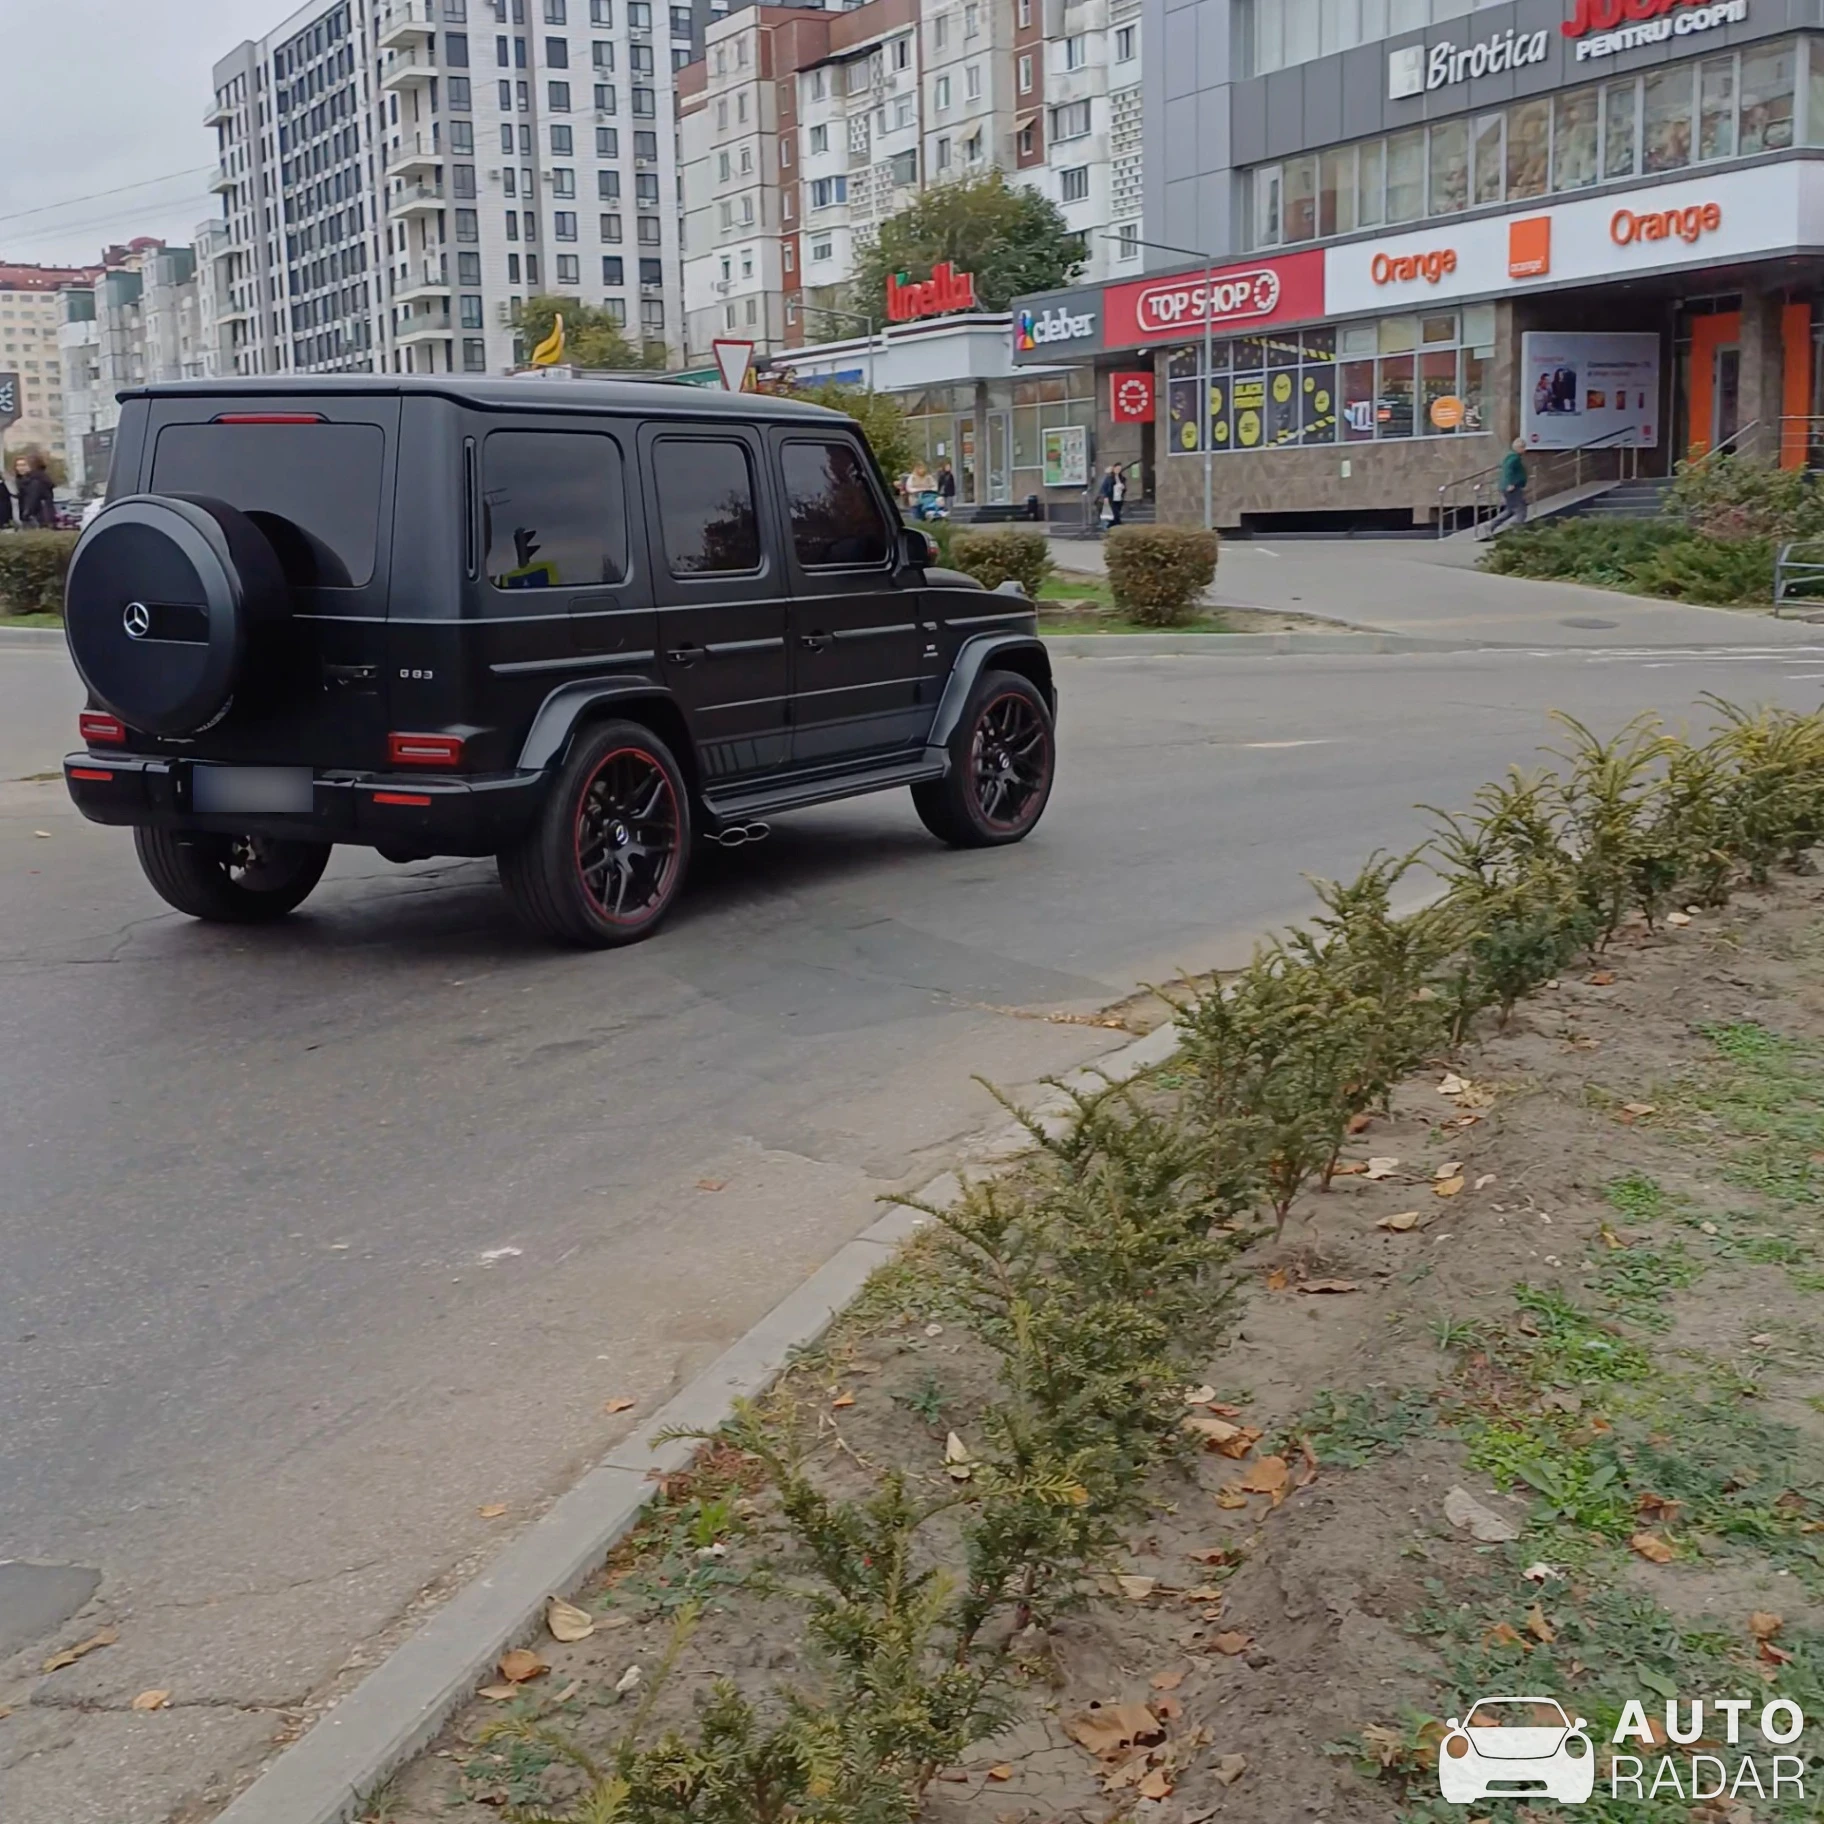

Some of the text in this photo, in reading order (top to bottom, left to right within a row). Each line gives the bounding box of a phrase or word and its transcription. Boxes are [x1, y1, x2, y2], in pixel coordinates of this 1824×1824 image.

[1576, 18, 1673, 62] PENTRU
[1674, 0, 1747, 35] COPII
[1426, 28, 1548, 90] Birotica
[1609, 202, 1721, 246] Orange
[1371, 248, 1457, 286] Orange
[1148, 282, 1251, 321] TOP SHOP
[1033, 307, 1096, 344] cleber
